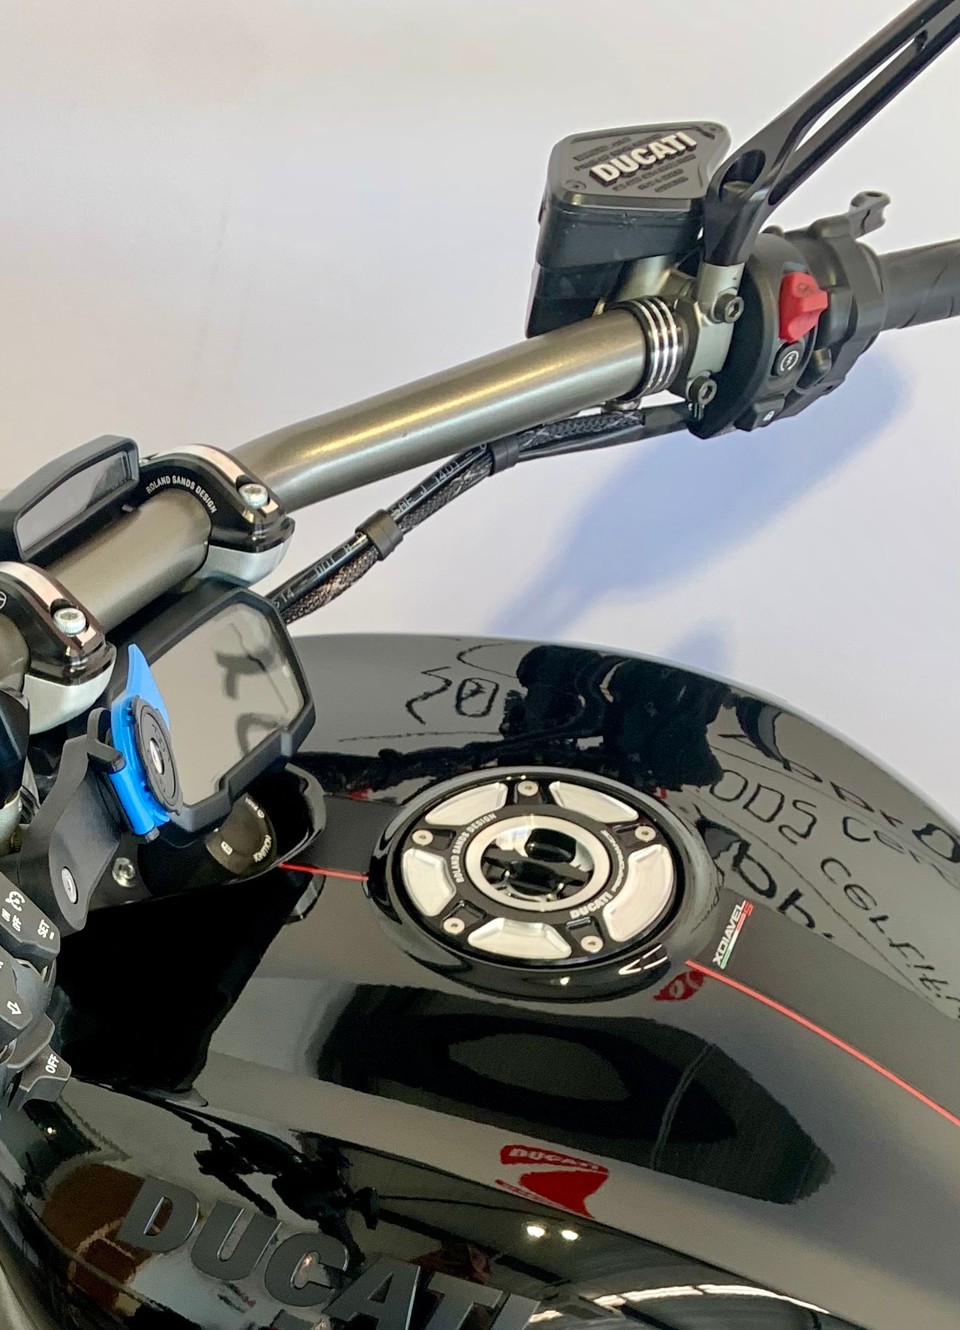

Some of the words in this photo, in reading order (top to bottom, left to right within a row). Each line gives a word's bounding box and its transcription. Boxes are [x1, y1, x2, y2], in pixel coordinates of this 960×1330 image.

[590, 131, 698, 186] DUCATI
[146, 475, 171, 494] ROLAND
[172, 474, 196, 491] SANDS
[195, 485, 218, 514] DESIGN
[469, 812, 497, 833] DESIGN
[452, 832, 470, 855] SANDS
[451, 856, 465, 884] ROLAND
[570, 892, 614, 919] DUCATI
[37, 919, 50, 939] SET
[712, 900, 746, 967] XDIAVEL
[45, 1053, 60, 1075] OFF
[508, 1148, 599, 1171] DUCATI
